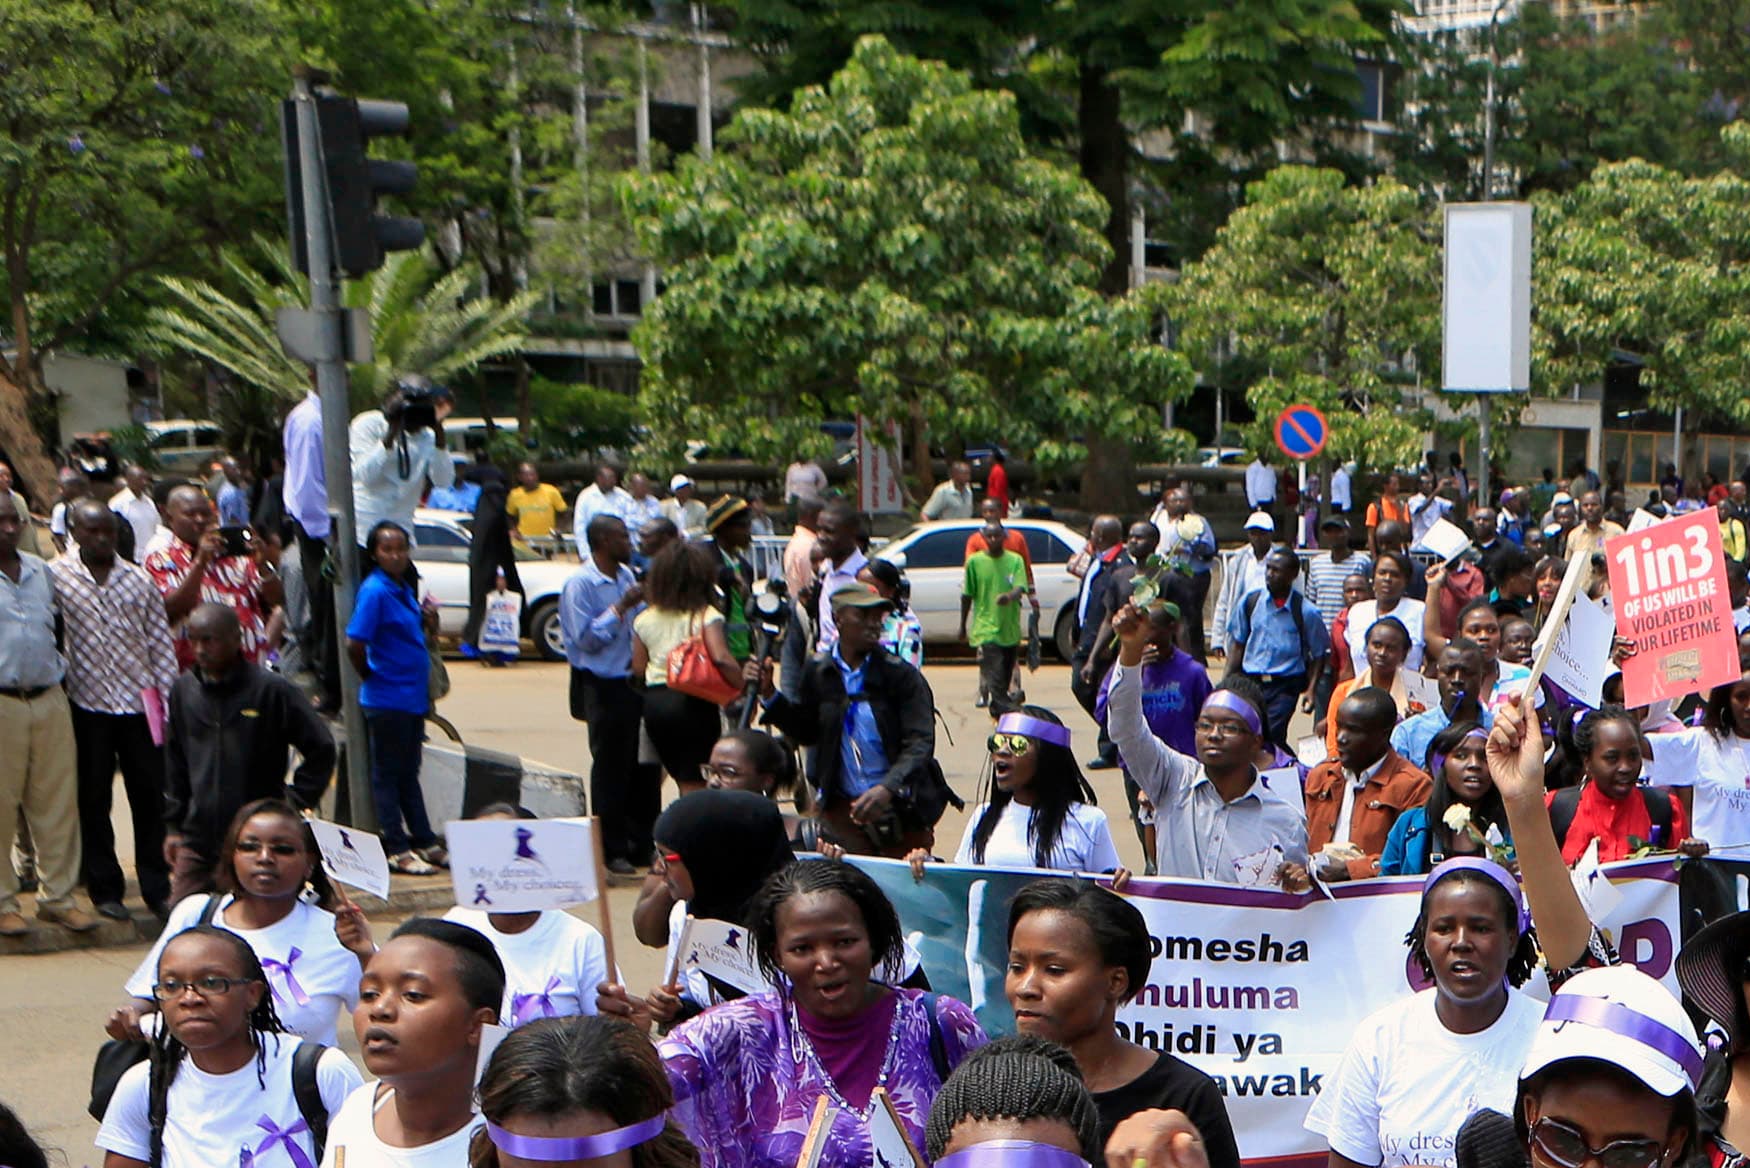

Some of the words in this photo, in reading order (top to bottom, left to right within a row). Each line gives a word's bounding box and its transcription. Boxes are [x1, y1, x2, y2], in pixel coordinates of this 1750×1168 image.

[1623, 602, 1642, 618] OF
[1644, 597, 1662, 612] US
[1662, 588, 1698, 608] WILL
[1698, 578, 1717, 597] BE
[1631, 605, 1695, 634] VIOLATED
[1699, 600, 1714, 615] IN
[1660, 616, 1722, 648] LIFETIME
[1728, 798, 1746, 812] My
[1232, 1032, 1283, 1063] ya
